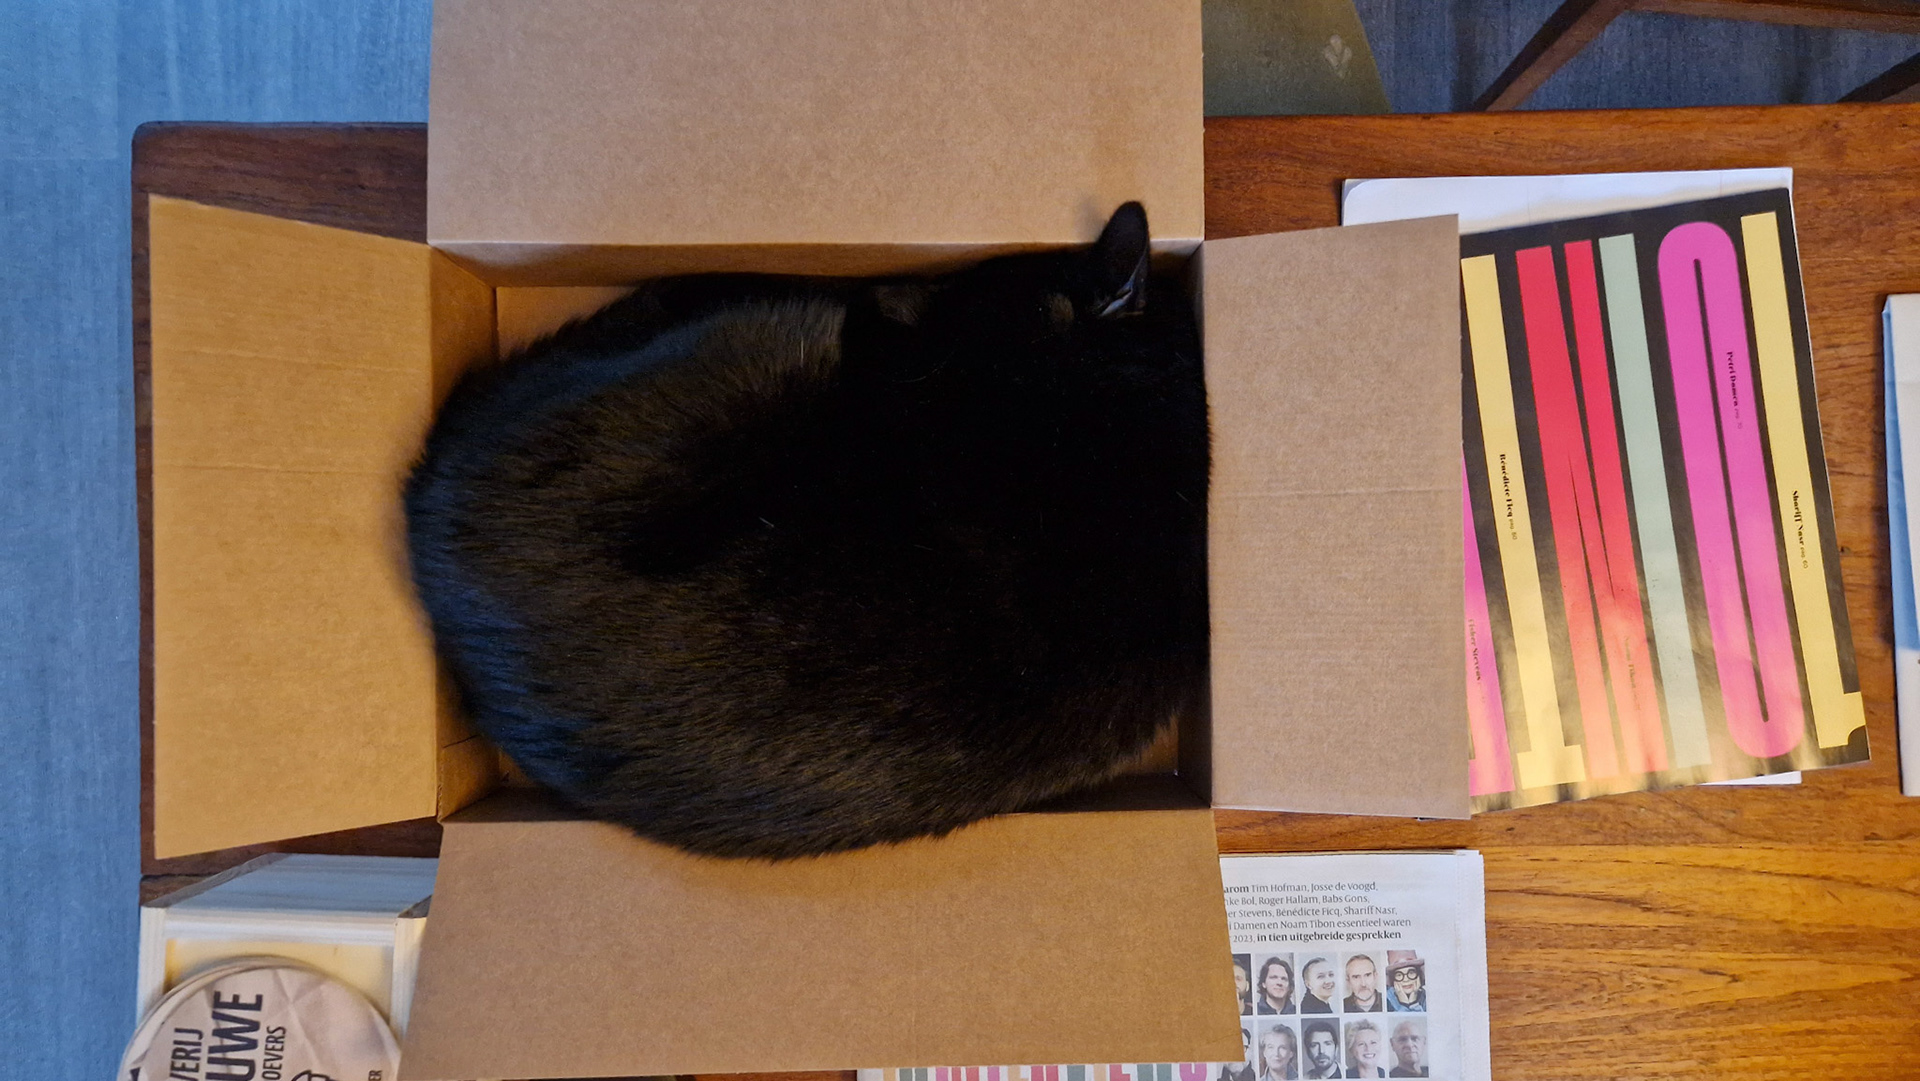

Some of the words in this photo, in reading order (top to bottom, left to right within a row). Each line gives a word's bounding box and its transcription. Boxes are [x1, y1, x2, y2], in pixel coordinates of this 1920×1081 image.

[1726, 351, 1736, 374] Petri
[1730, 375, 1739, 407] Damen
[1792, 490, 1803, 523] Shariff
[1251, 884, 1269, 892] Tim
[1270, 882, 1309, 893] Hofman,
[1311, 882, 1334, 893] Josse
[1335, 881, 1346, 891] de
[1347, 881, 1379, 892] Voogd,
[1241, 896, 1257, 906] Bol,
[1258, 896, 1284, 907] Roger
[1285, 894, 1321, 905] Hallam,
[1322, 894, 1343, 904] Babs
[1344, 894, 1370, 904] Gons,
[1238, 909, 1275, 918] Stevens,
[1276, 907, 1320, 917] Bénédicte
[1321, 907, 1343, 917] Ficq,
[1343, 905, 1374, 915] Shariff
[1375, 906, 1398, 916] Nasr,
[1233, 921, 1266, 930] Damen
[1267, 922, 1278, 930] en
[1280, 920, 1308, 929] Noam
[1310, 919, 1335, 928] Tibon
[1336, 918, 1381, 928] essentieel
[1382, 919, 1411, 927] waren
[1233, 935, 1256, 943] 2023,
[1257, 933, 1267, 942] in
[1269, 933, 1288, 942] tien
[1289, 931, 1345, 943] uitgebreide
[1345, 930, 1402, 942] gesprekken
[205, 990, 263, 1081] UWE
[261, 1025, 287, 1081] OEVERS
